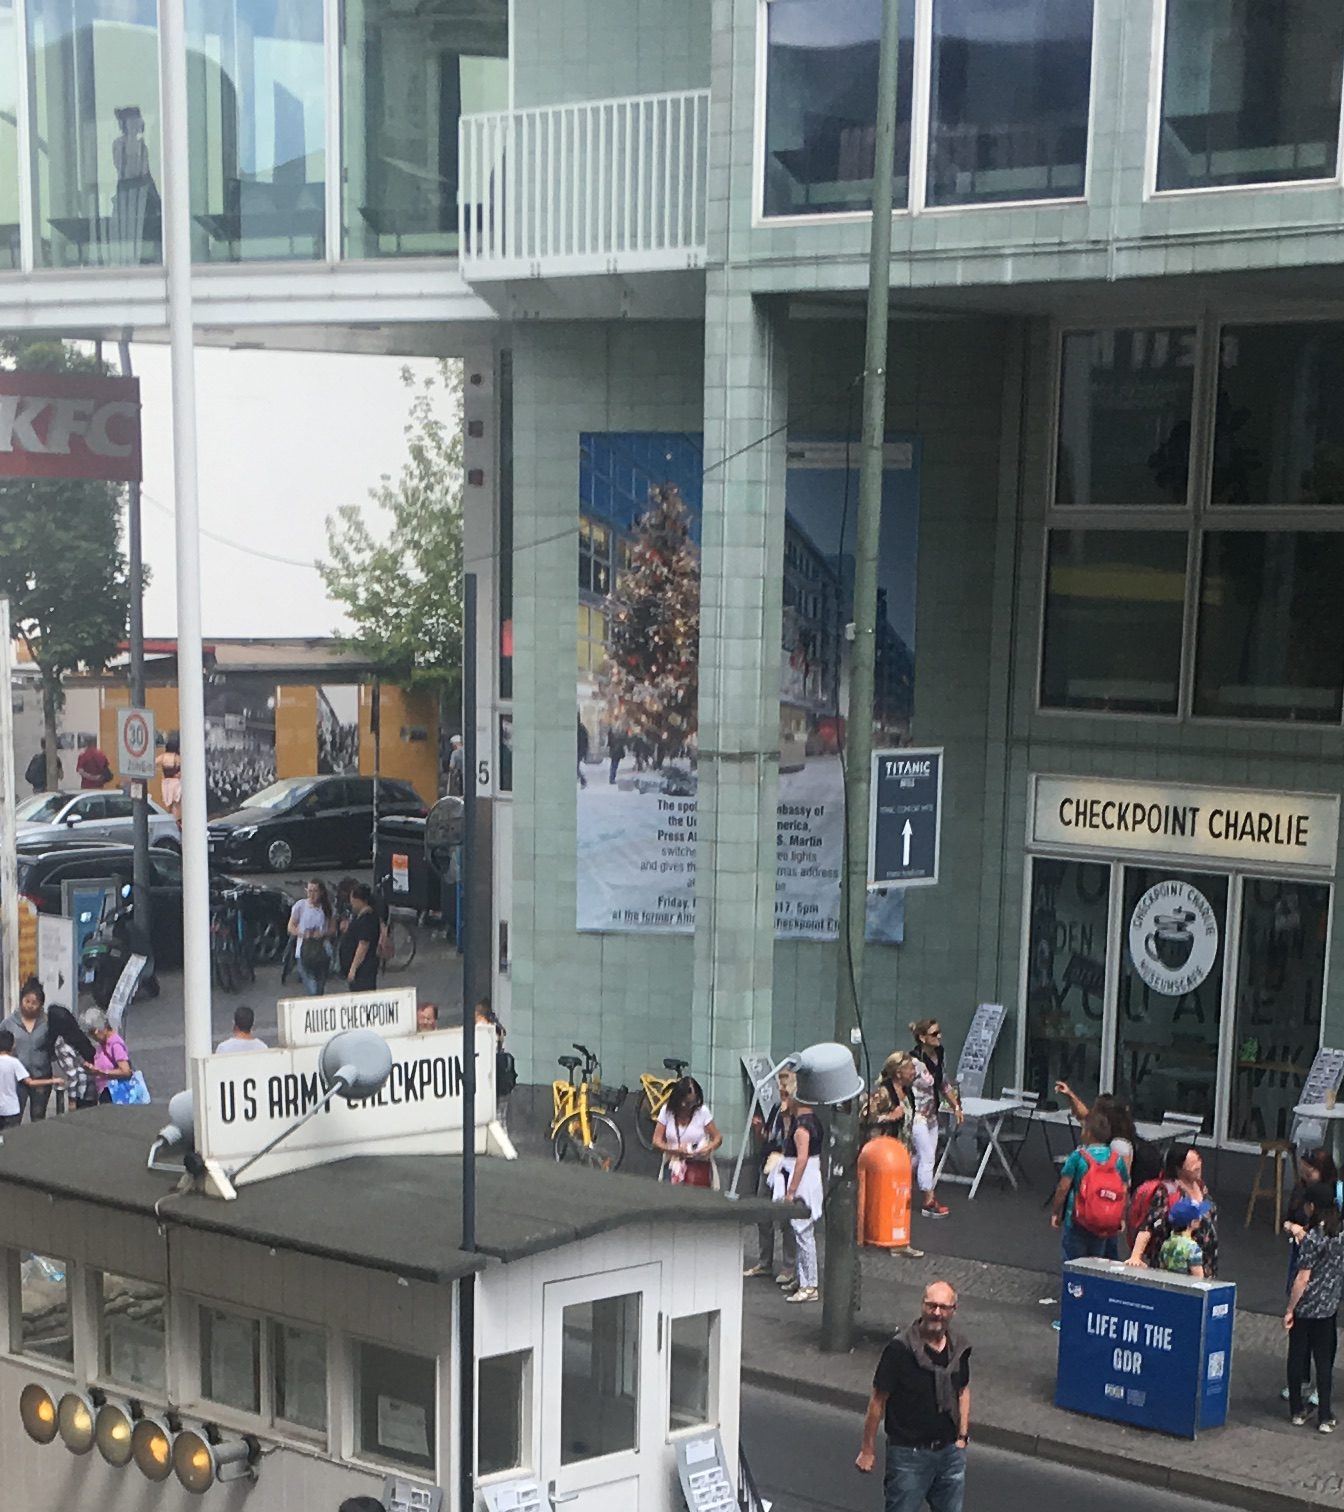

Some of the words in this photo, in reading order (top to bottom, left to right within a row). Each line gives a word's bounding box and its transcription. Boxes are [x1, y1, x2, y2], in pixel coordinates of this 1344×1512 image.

[129, 724, 144, 746] 30
[478, 760, 490, 785] 5
[885, 761, 930, 775] TITANIC
[657, 799, 674, 811] The
[814, 805, 824, 816] of
[668, 816, 683, 826] the
[1059, 798, 1200, 837] CHECKPOINT
[1208, 809, 1309, 846] CHARLIE
[657, 829, 684, 841] Press
[790, 835, 822, 847] Martin
[640, 860, 657, 871] and
[1133, 883, 1184, 928] CHECKPOINT
[1188, 889, 1216, 936] CHARLIE
[304, 1007, 336, 1033] ALLIED
[340, 1001, 399, 1030] CHECKPOINT
[1087, 1312, 1118, 1338] LIFE
[1122, 1319, 1139, 1344] IN
[1144, 1324, 1173, 1351] THE
[1113, 1348, 1142, 1375] GDR
